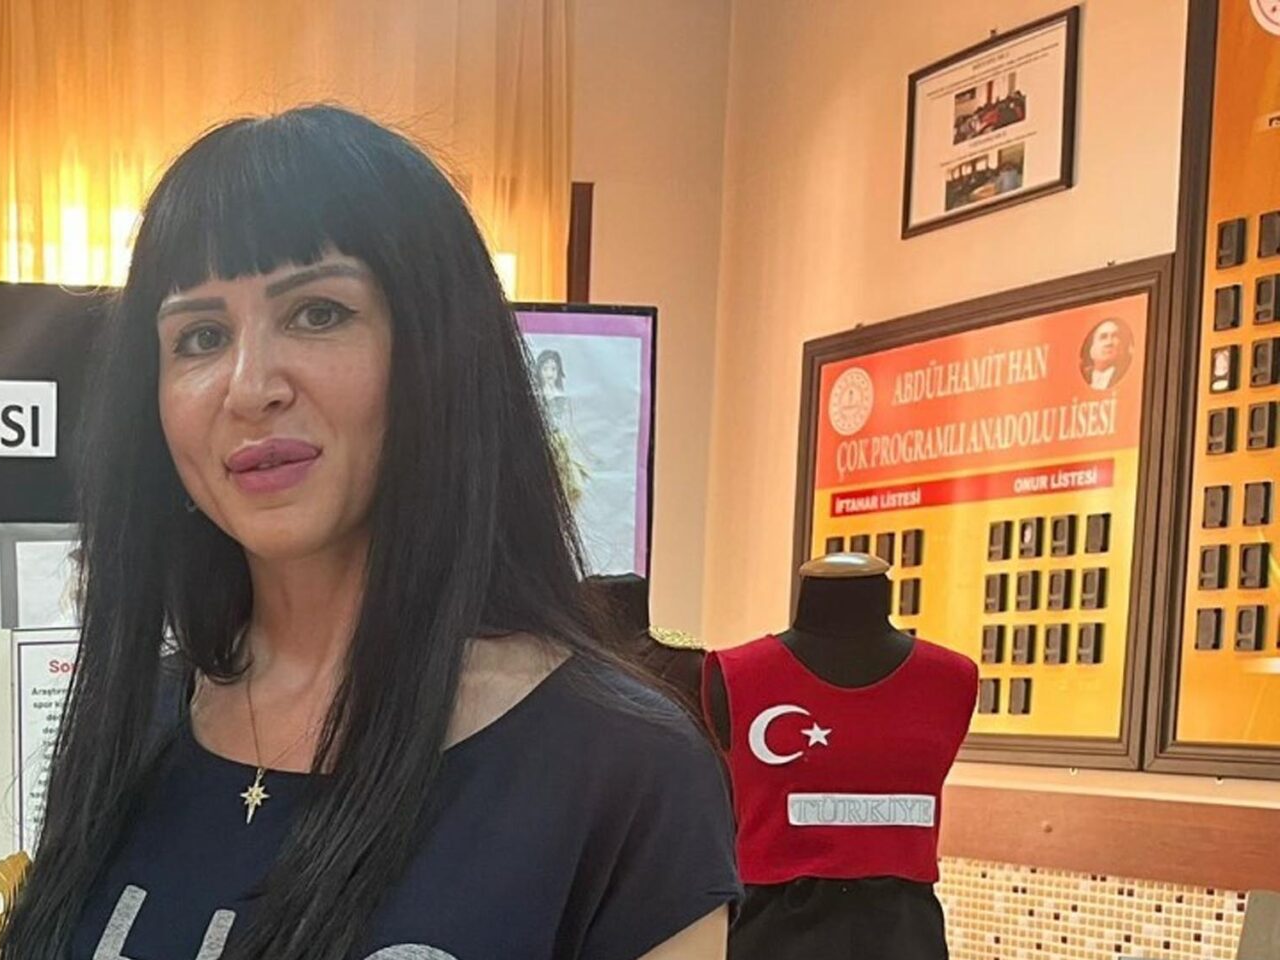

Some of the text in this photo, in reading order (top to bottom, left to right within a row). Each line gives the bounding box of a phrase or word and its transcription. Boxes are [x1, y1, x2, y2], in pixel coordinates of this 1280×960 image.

[891, 344, 1050, 406] ABDÜLHAMİT HAN
[836, 391, 1119, 482] ÇOK PROGRAMLI ANADOLU LİSESİ
[1013, 468, 1098, 494] ONUR LİSTESİ
[790, 796, 933, 824] TÜRKİYE
